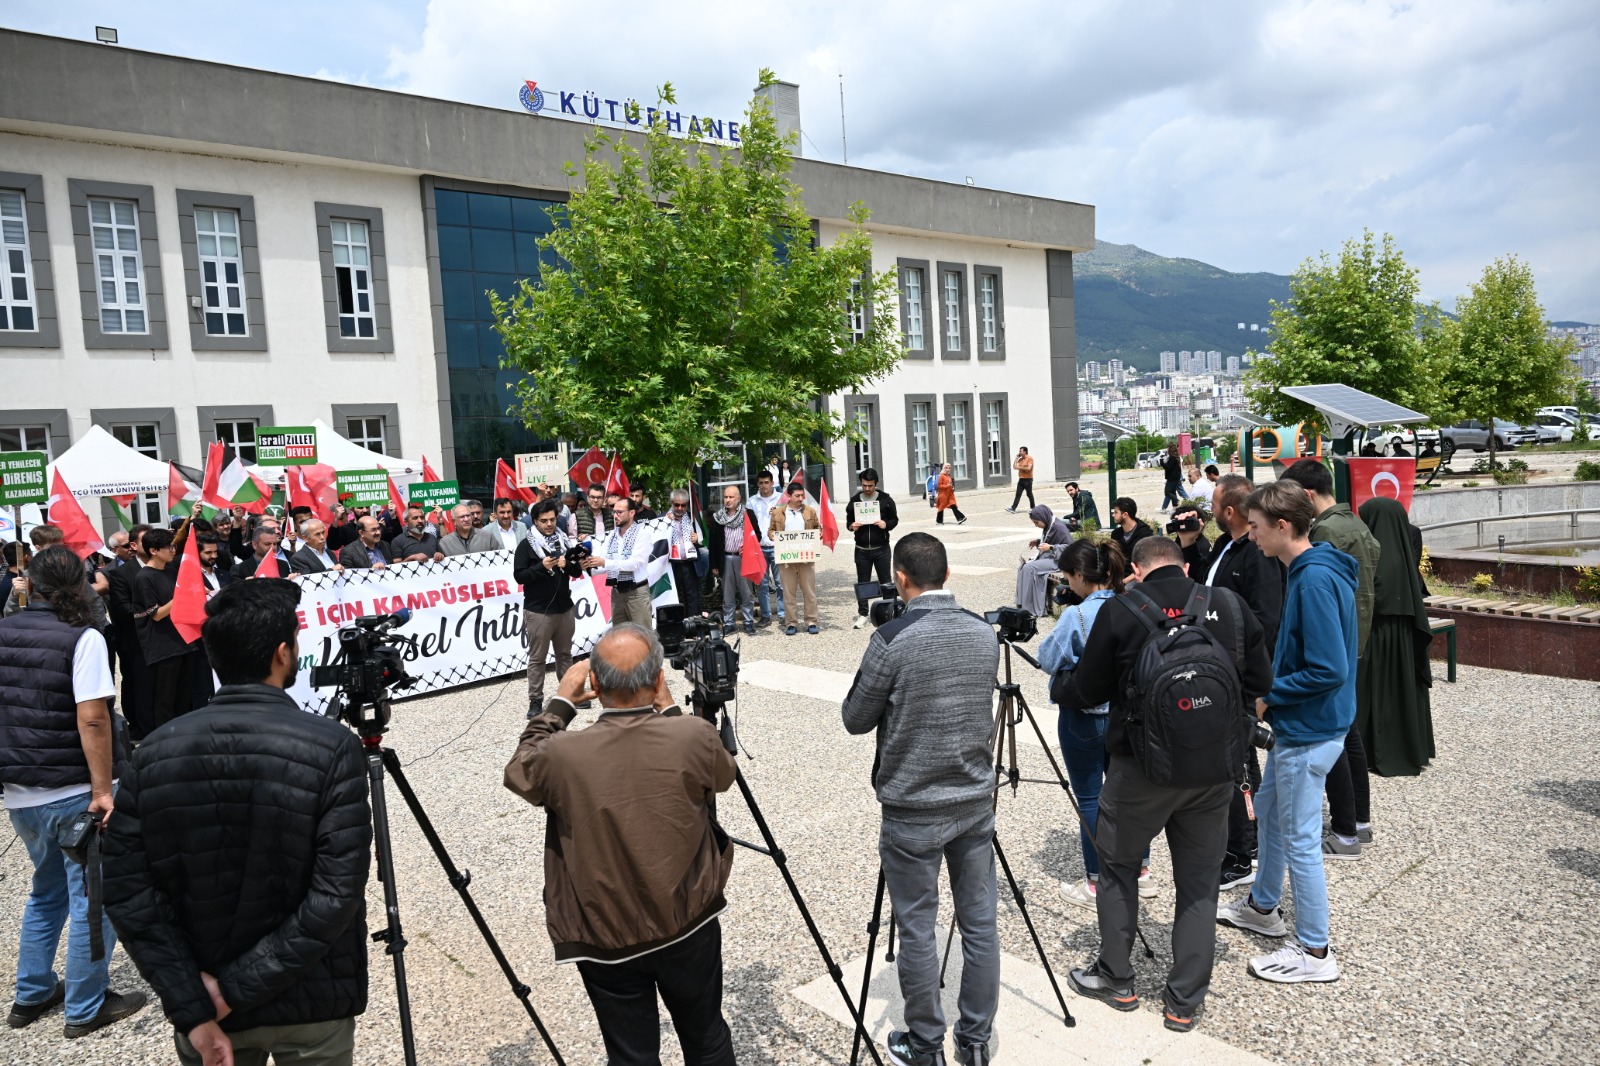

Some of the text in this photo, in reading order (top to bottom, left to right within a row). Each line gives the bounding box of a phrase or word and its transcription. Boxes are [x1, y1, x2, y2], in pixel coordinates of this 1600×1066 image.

[559, 89, 741, 142] KÜTÜPHANE
[287, 447, 314, 457] DEVLET
[3, 471, 43, 485] DİRENİŞ
[528, 475, 547, 484] LIVE
[5, 488, 44, 499] KAZANACAK
[356, 491, 389, 501] ISIRACAK
[412, 490, 428, 498] AKSA
[779, 532, 815, 541] STOP THE
[317, 598, 365, 629] İÇİN
[374, 579, 510, 616] KAMPÜSLER
